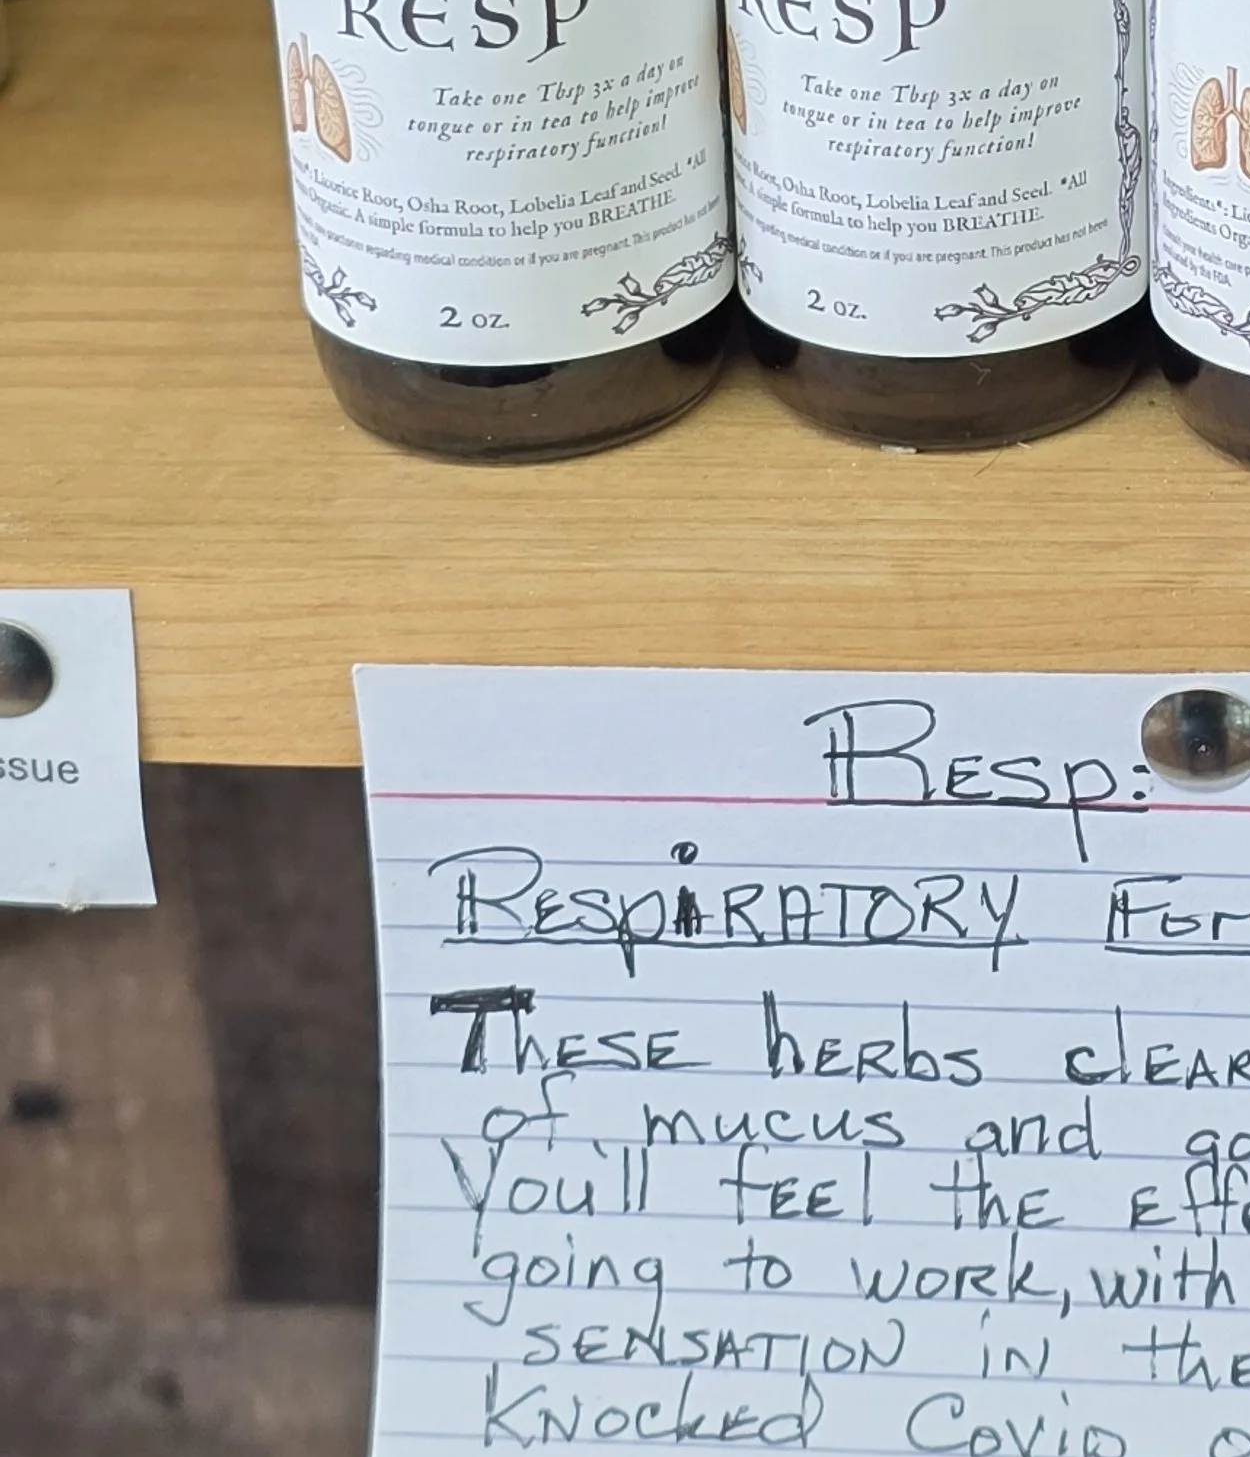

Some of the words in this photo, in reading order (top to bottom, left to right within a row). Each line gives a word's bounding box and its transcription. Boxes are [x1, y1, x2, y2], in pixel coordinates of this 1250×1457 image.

[433, 87, 483, 107] Take
[492, 92, 527, 106] one
[536, 81, 585, 106] Tbsp
[593, 79, 614, 99] 3x
[620, 75, 630, 87] a
[636, 61, 664, 87] day
[669, 55, 684, 72] on
[800, 74, 843, 98] Take
[850, 86, 881, 102] one
[891, 84, 940, 111] Tbsp
[948, 90, 972, 107] 3x
[979, 87, 991, 101] a
[998, 78, 1033, 102] day
[1039, 76, 1059, 91] on
[408, 118, 474, 141] tongue
[482, 120, 503, 134] or
[511, 115, 532, 133] in
[542, 114, 571, 130] tea
[580, 110, 599, 126] to
[606, 99, 640, 121] help
[782, 99, 835, 127] tongue
[842, 113, 861, 127] or
[868, 111, 888, 130] in
[895, 118, 925, 131] tea
[935, 115, 954, 131] to
[962, 109, 1001, 133] help
[1009, 94, 1081, 127] improve
[465, 139, 580, 168] respiratory
[582, 113, 668, 158] function!
[827, 137, 934, 164] respiratory
[937, 132, 1035, 164] function!
[439, 305, 464, 330] 2
[471, 311, 511, 332] oz.
[806, 288, 826, 313] 2
[832, 299, 867, 320] oz.
[0, 757, 79, 784] sue
[481, 1071, 569, 1152] of
[643, 1103, 905, 1149] mucus
[963, 1093, 1101, 1160] and
[464, 1235, 664, 1351] going
[725, 1236, 793, 1292] to
[1090, 1238, 1234, 1311] with
